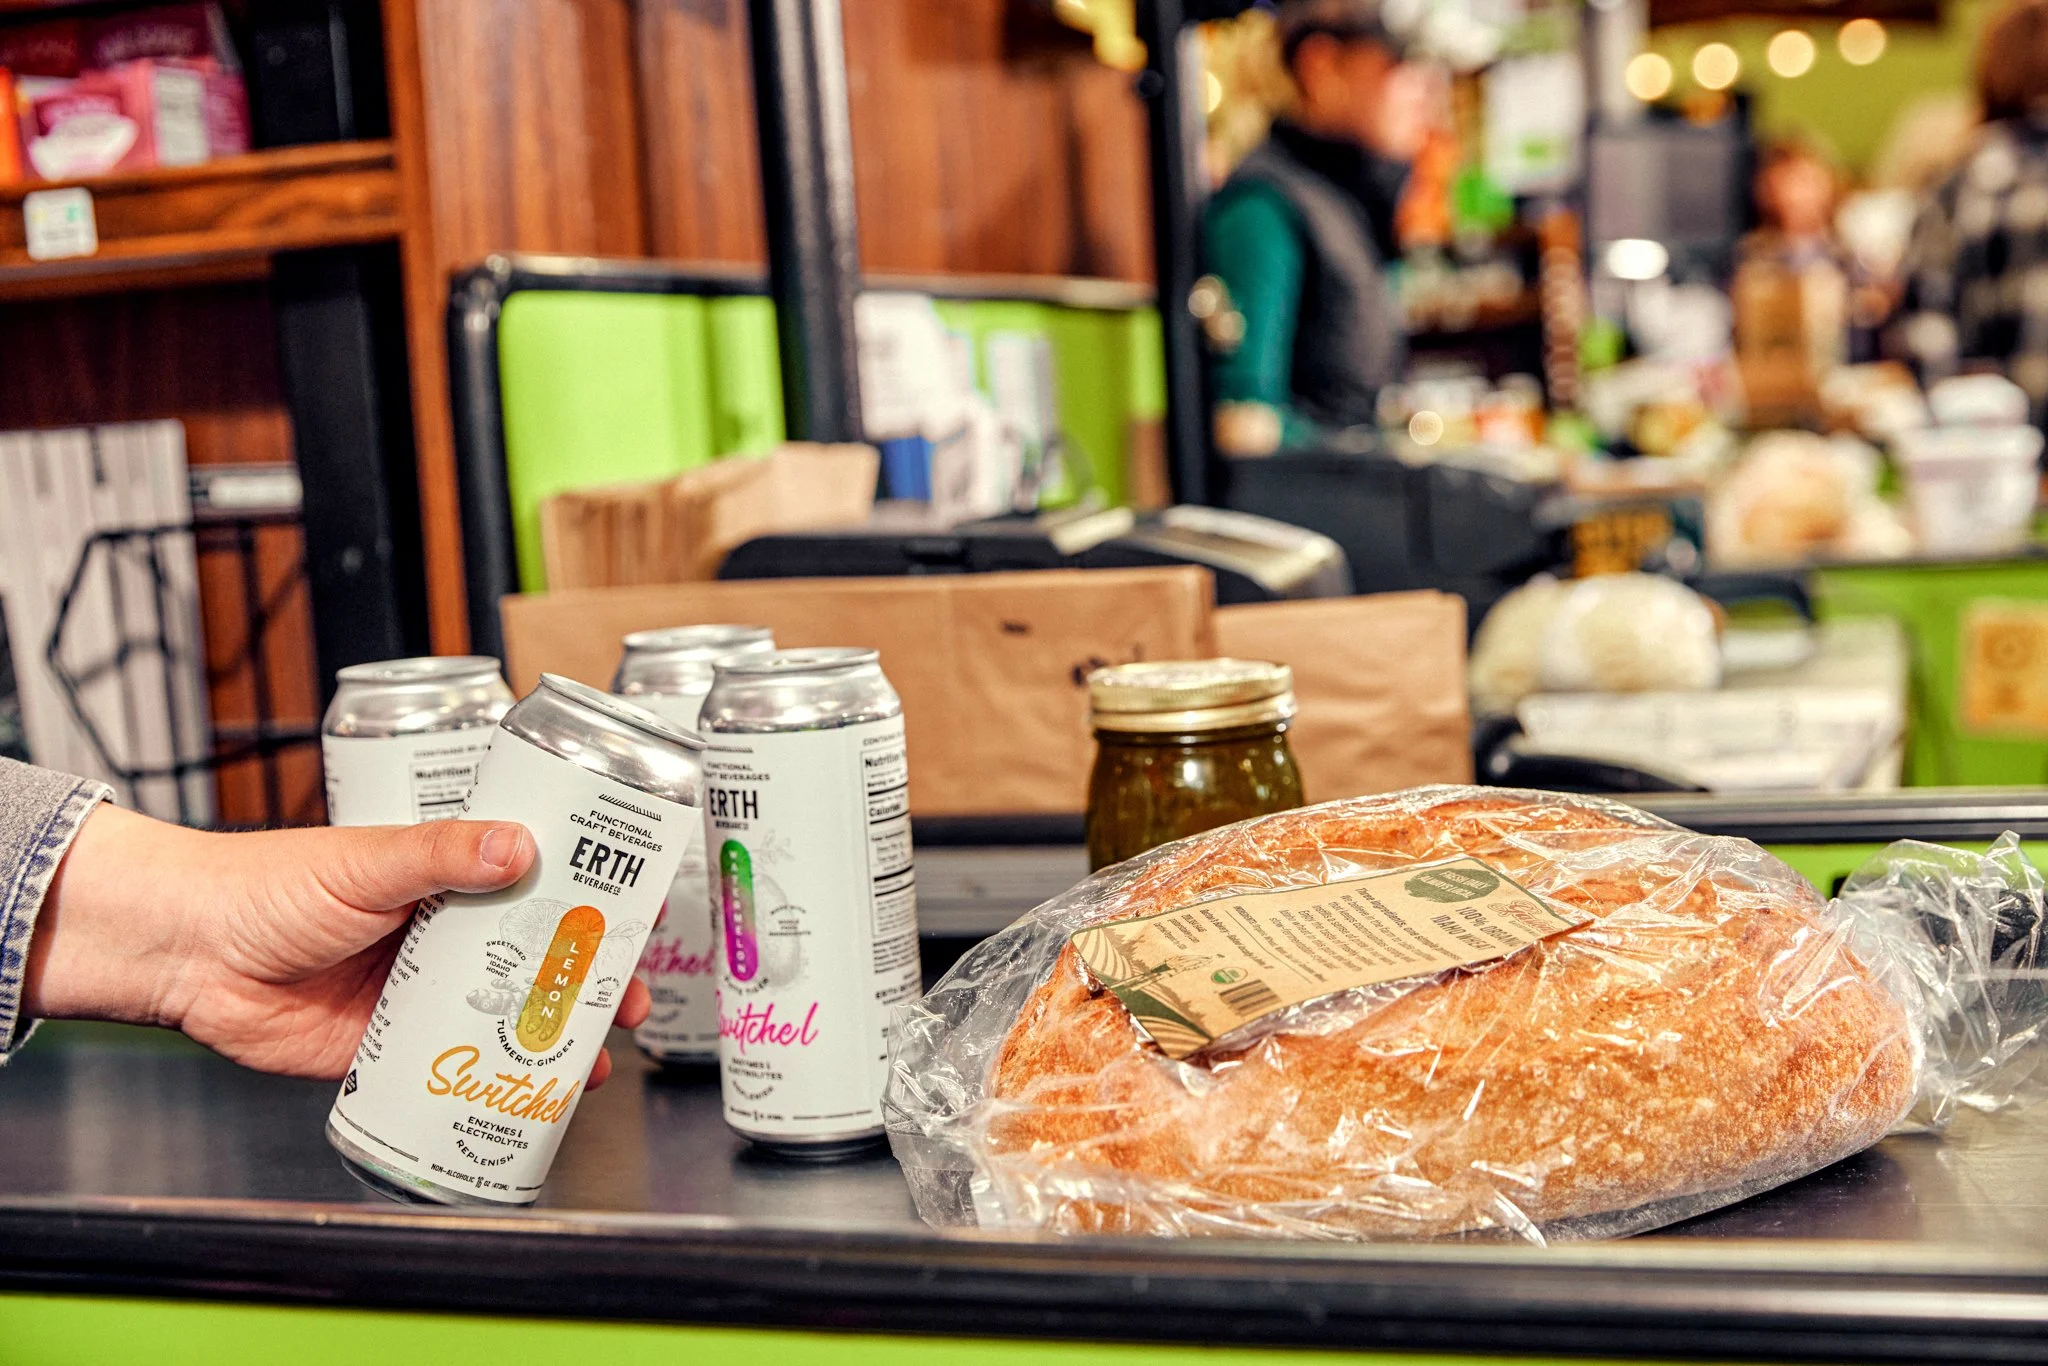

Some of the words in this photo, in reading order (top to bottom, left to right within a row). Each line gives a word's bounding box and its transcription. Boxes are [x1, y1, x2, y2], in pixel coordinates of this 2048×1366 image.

[710, 788, 759, 819] ERTH
[570, 814, 607, 833] CRAFT
[608, 829, 663, 852] BEVERAGES
[590, 810, 653, 839] FUNCTIONAL
[569, 836, 645, 888] ERTH
[573, 872, 613, 894] BEVERAGE
[1326, 901, 1344, 910] that
[1337, 909, 1357, 923] keeps
[1339, 894, 1353, 902] We
[1347, 901, 1370, 916] believe
[1369, 919, 1385, 927] the
[1354, 887, 1376, 900] Three
[1402, 926, 1419, 936] one
[1456, 907, 1489, 927] 100%
[1330, 921, 1351, 934] sense
[1430, 914, 1466, 935] IDAHO
[1456, 933, 1496, 950] WHEAT
[486, 940, 527, 961] SWEETENED
[486, 951, 502, 962] WITH
[503, 958, 519, 969] RAW
[486, 966, 510, 979] HONEY
[489, 960, 511, 973] IDAHO
[541, 942, 579, 1019] LEMON
[427, 1045, 581, 1124] Switchel
[453, 1121, 529, 1150] ELECTROLYTES
[468, 1116, 517, 1136] ENZYMES
[456, 1139, 514, 1167] REPLENISH
[430, 1163, 476, 1183] NON-ALCOHOLIC
